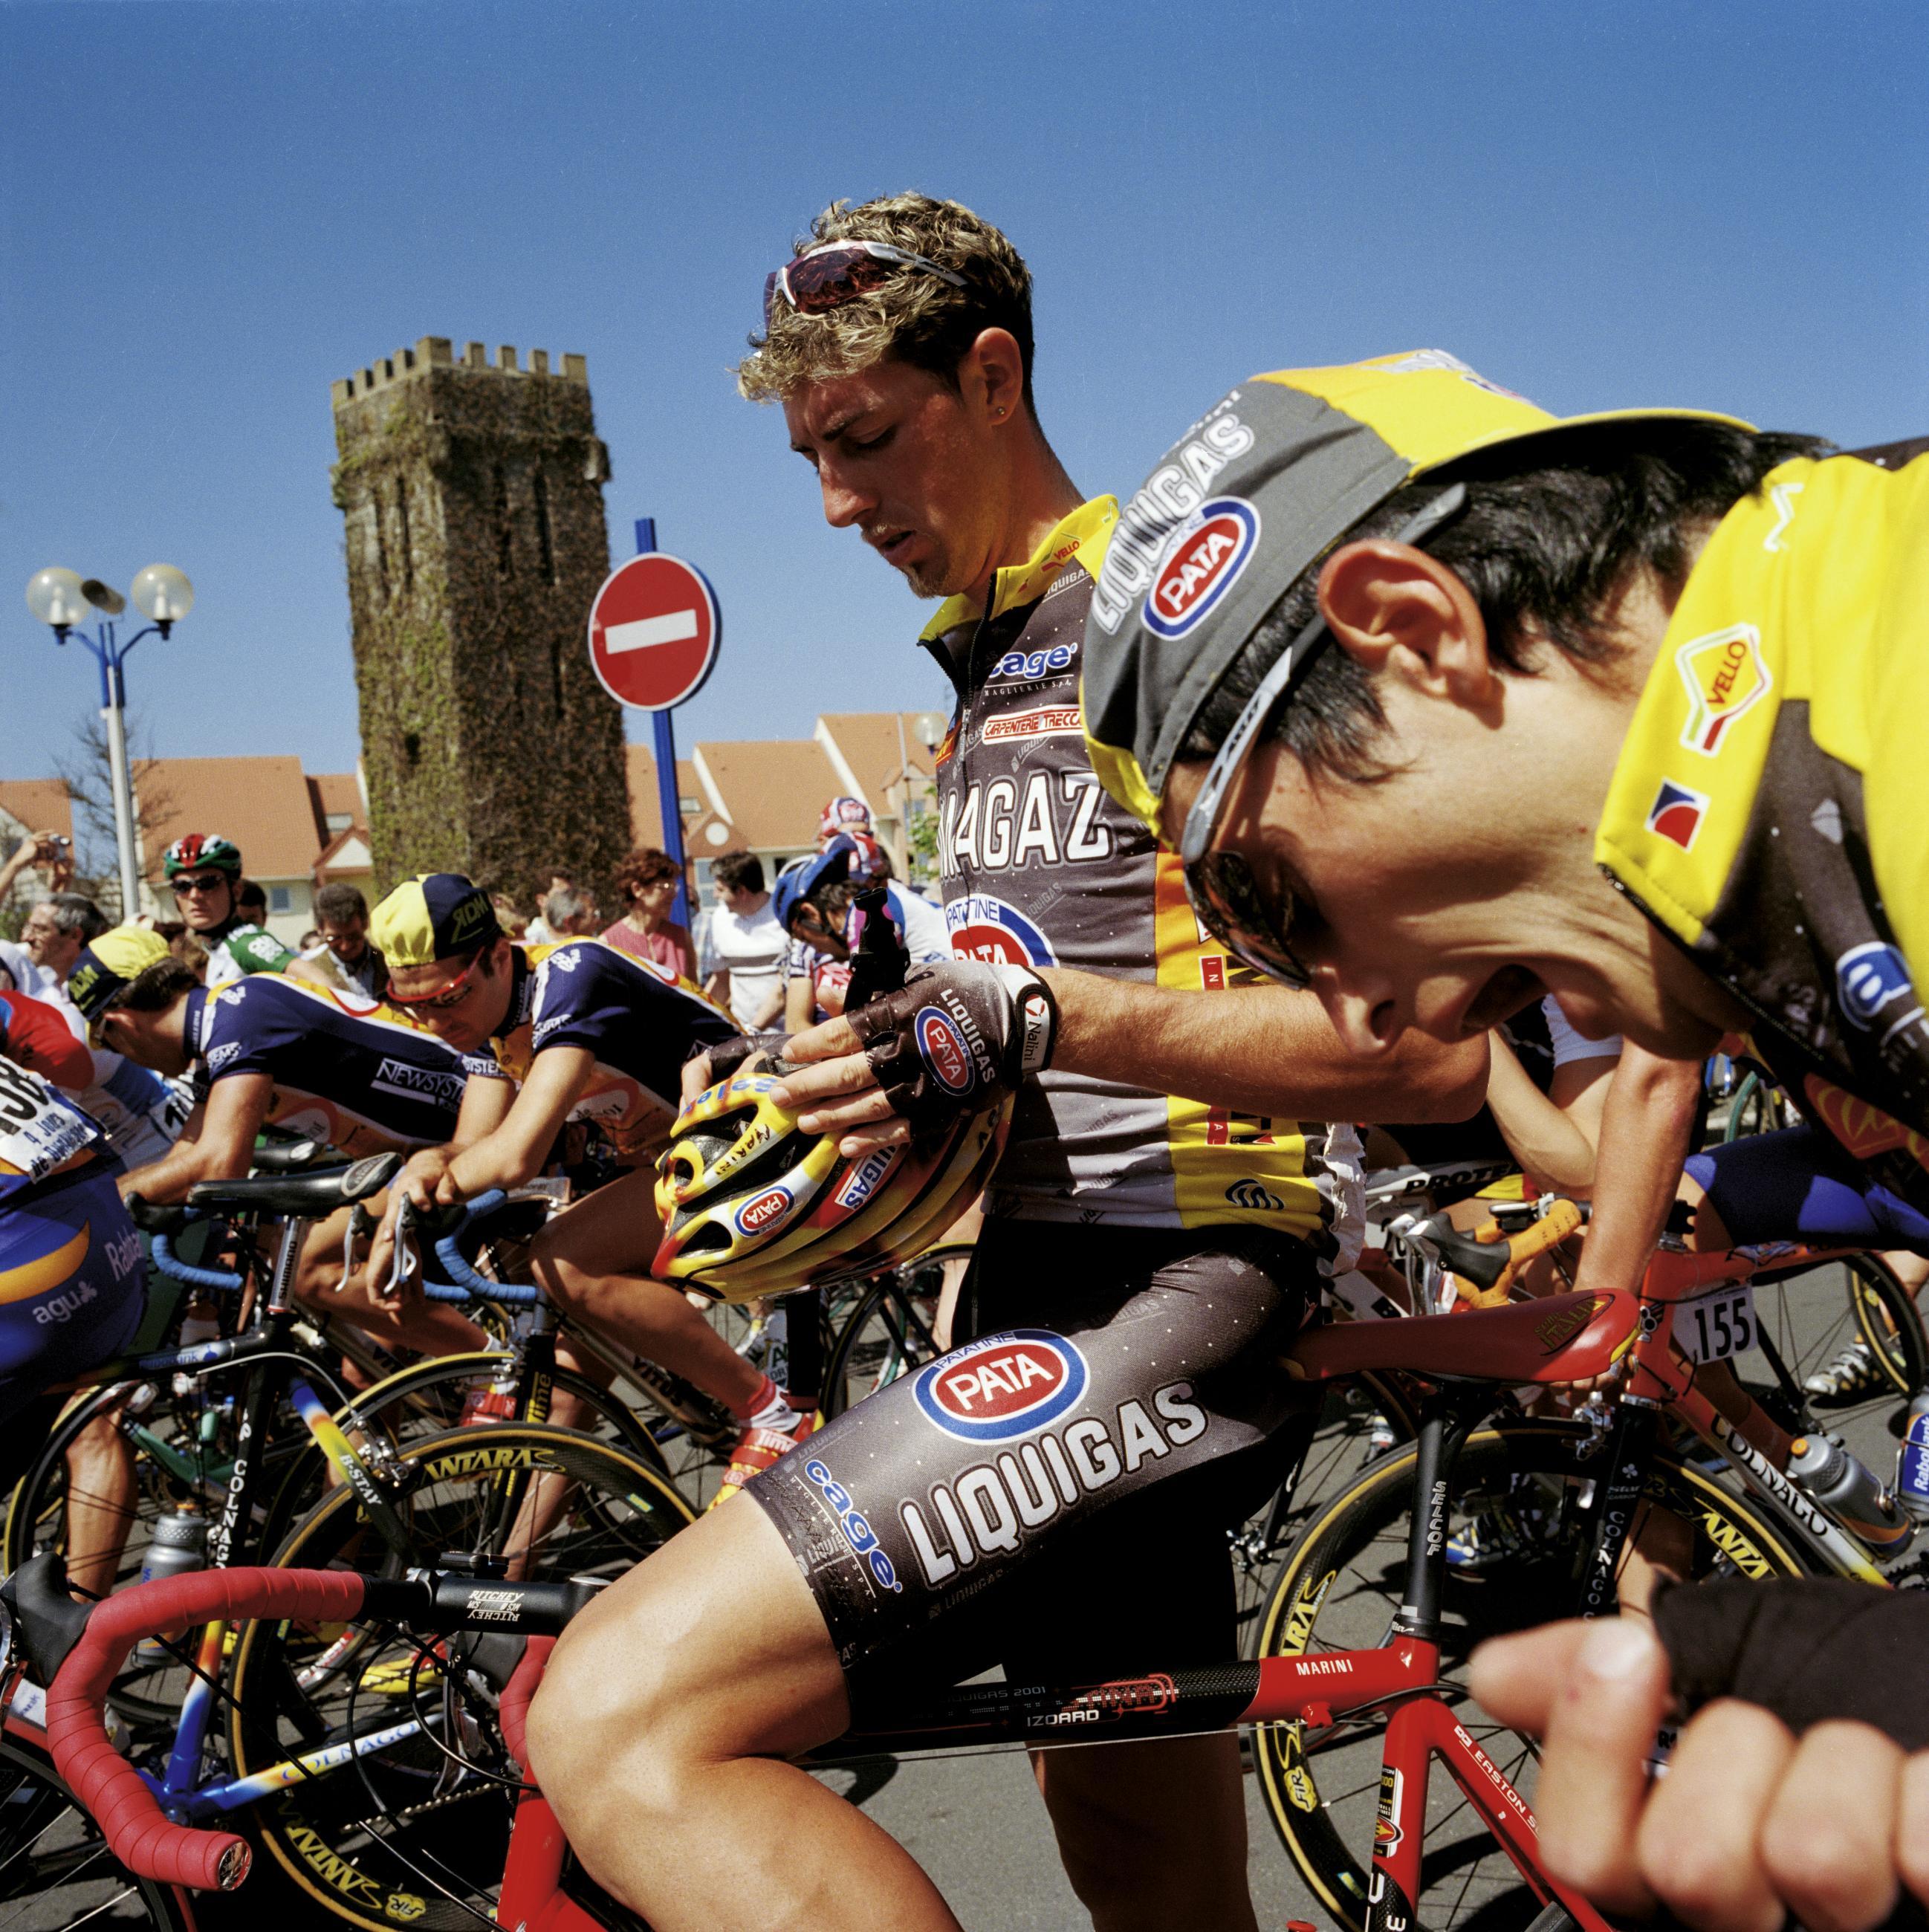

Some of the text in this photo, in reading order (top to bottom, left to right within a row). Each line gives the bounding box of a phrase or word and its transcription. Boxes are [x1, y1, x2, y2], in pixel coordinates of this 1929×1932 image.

[1054, 539, 1080, 560] VELLO
[1092, 414, 1255, 635] LIQUIGAS
[1159, 532, 1235, 612] PATA
[1706, 641, 1746, 704] VELLO
[985, 717, 1039, 736] CARPENTERIE
[930, 1025, 963, 1080] PATA
[940, 988, 995, 1083] LIQUIGAS
[947, 1022, 973, 1068] PATATINE
[1024, 1021, 1041, 1061] Nalini
[745, 1192, 783, 1225] PATA
[937, 1332, 1014, 1369] PATATINE
[1695, 1297, 1750, 1361] 155
[946, 1353, 1053, 1410] PATA
[899, 1381, 1207, 1589] LIQUIGAS
[1711, 1411, 1828, 1537] COLNAGO
[805, 1459, 896, 1589] cage
[1427, 1481, 1447, 1555] SELCOF
[1587, 1511, 1626, 1605] COLNAGO
[467, 1610, 520, 1622] RITCHEY
[468, 1590, 525, 1603] RITCHEY
[1014, 1686, 1046, 1698] 2001
[1296, 1659, 1354, 1676] MARINI
[1027, 1708, 1100, 1728] IZOARD
[1290, 1769, 1311, 1809] FIR
[1474, 1749, 1526, 1815] EASTON
